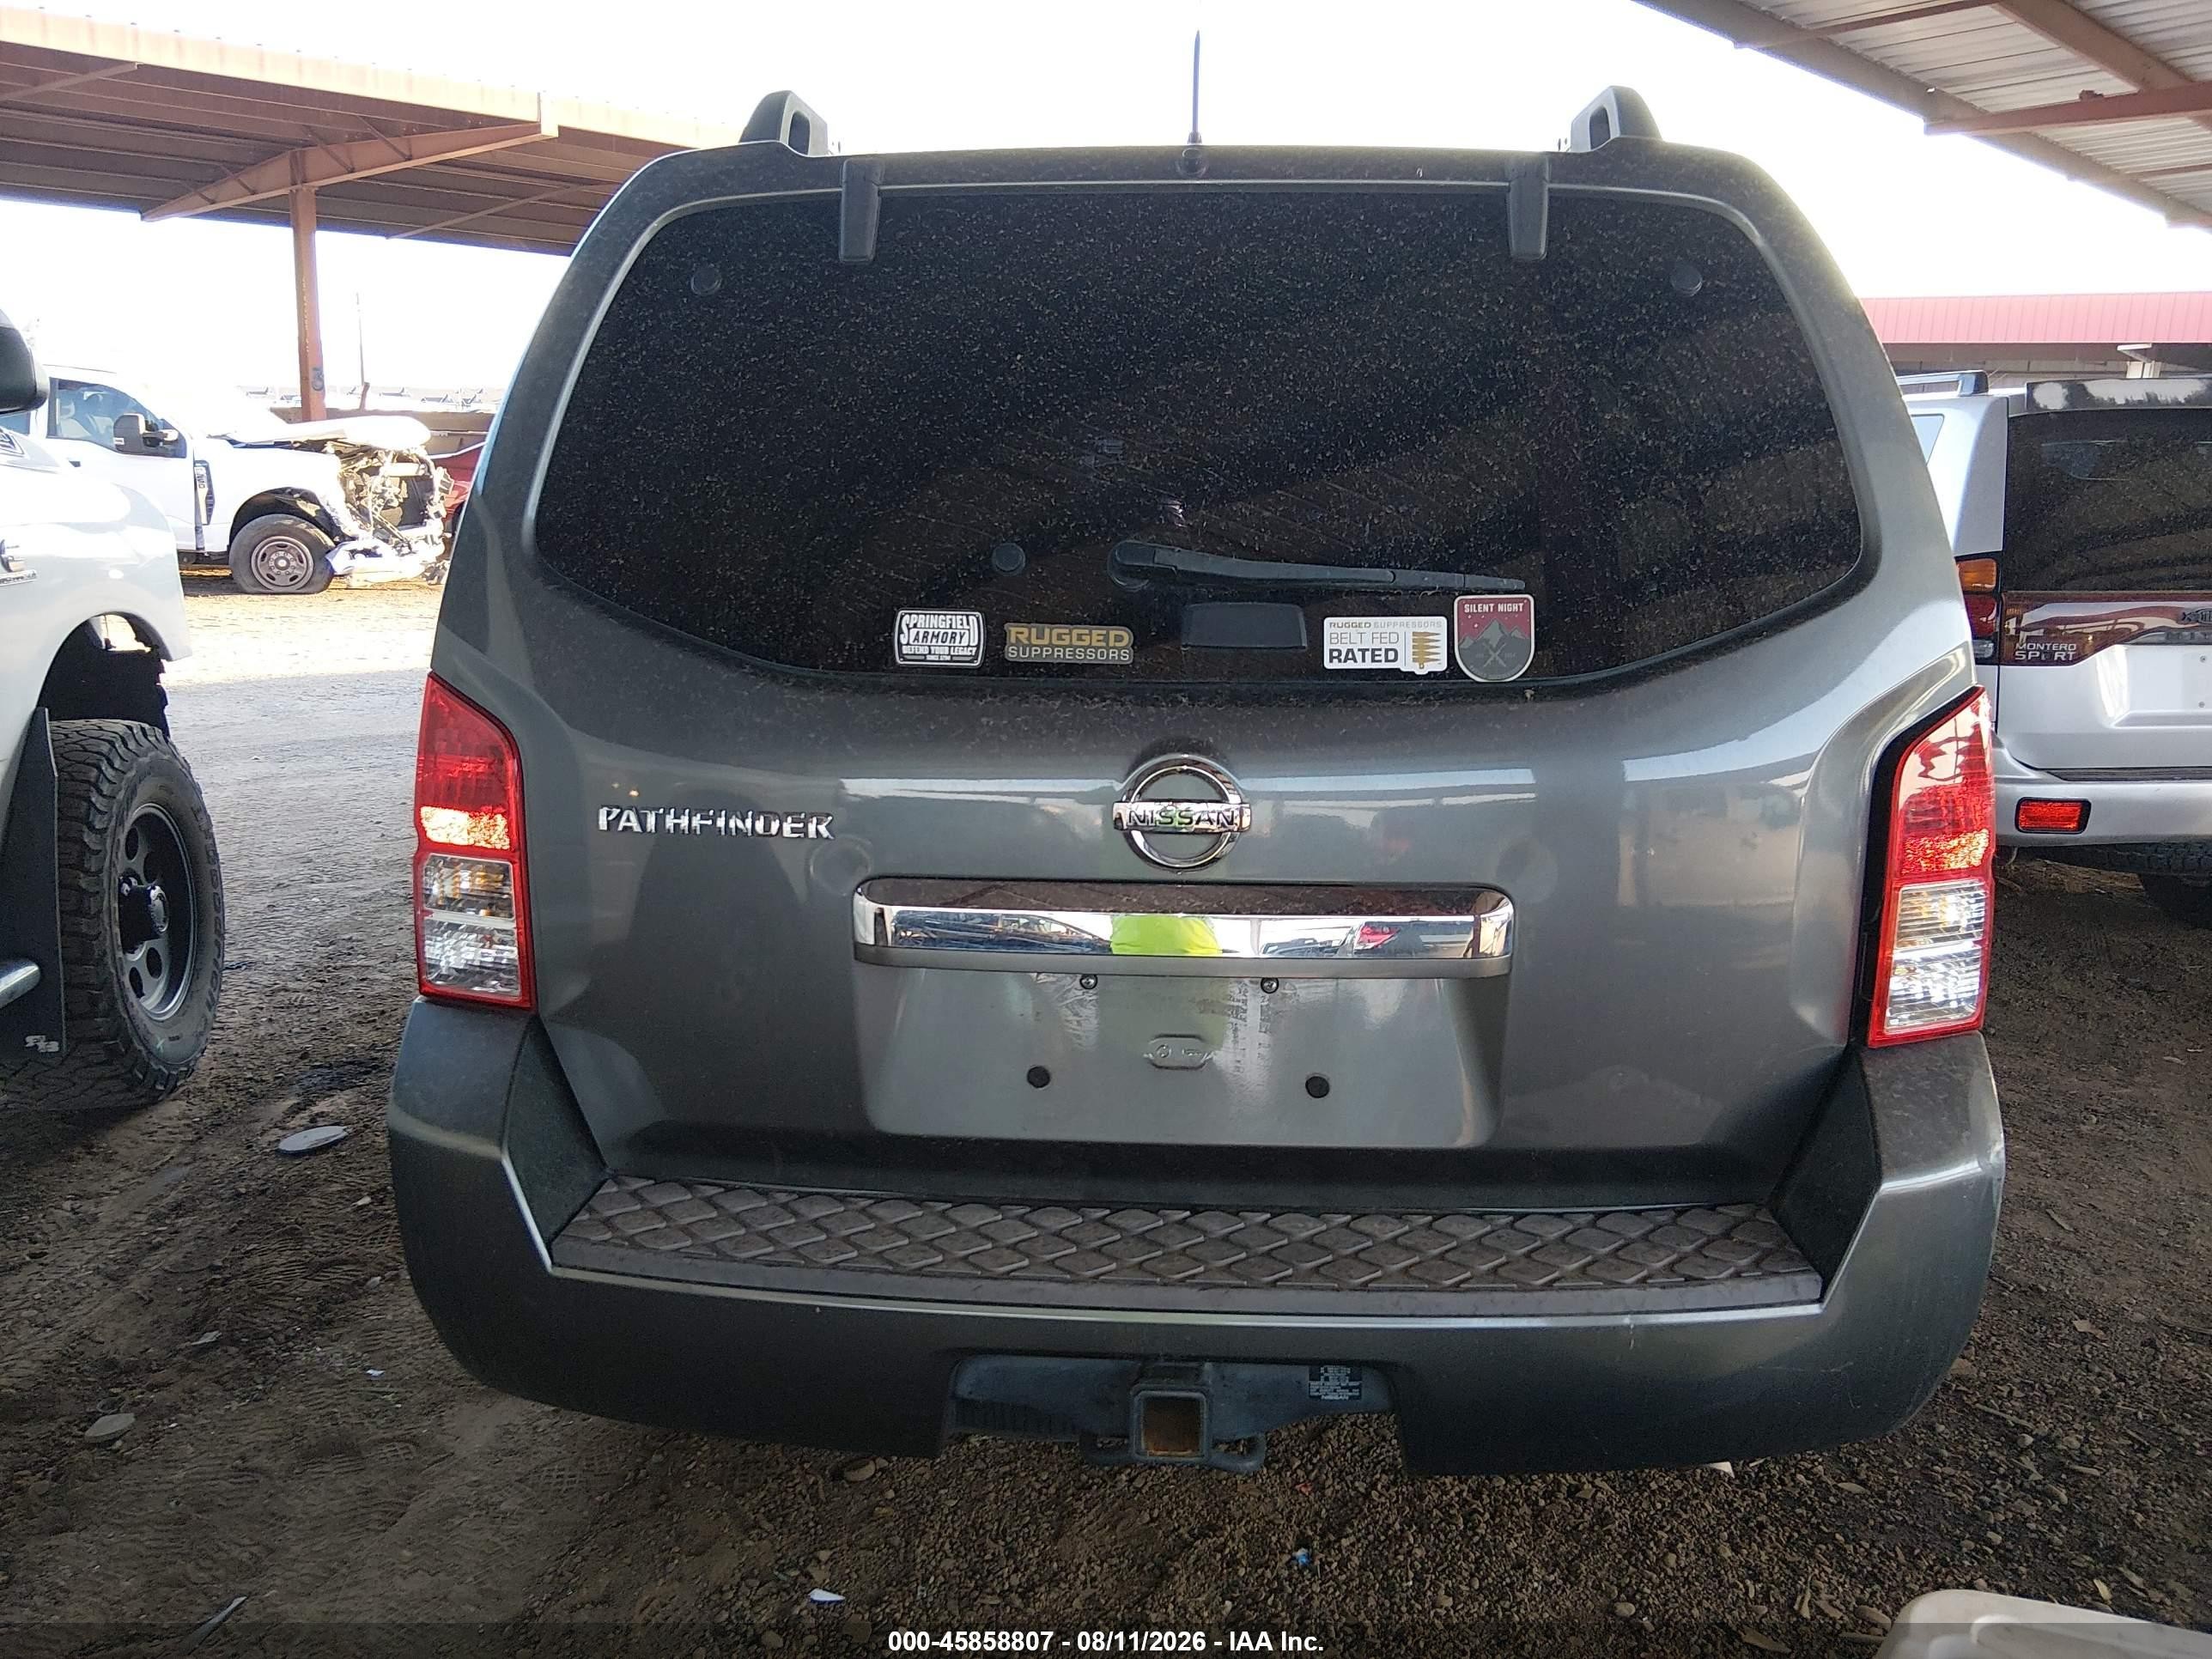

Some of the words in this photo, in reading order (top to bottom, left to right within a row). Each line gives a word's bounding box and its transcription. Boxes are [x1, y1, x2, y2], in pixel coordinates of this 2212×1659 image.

[1464, 604, 1494, 612] SILENT
[1498, 603, 1524, 612] NIGHT
[899, 614, 979, 646] SPRINGFIELD
[912, 630, 966, 645] ARMORY
[1007, 627, 1130, 647] RUGGED
[1329, 632, 1367, 645] BELT
[1371, 631, 1400, 645] FED
[950, 647, 977, 656] LEGACY
[1007, 646, 1130, 661] SUPPRESSORS
[2015, 642, 2077, 651] MONTERO
[1328, 647, 1399, 663] RATED
[598, 805, 836, 841] PATHFINDER
[1127, 809, 1236, 827] NISSAN
